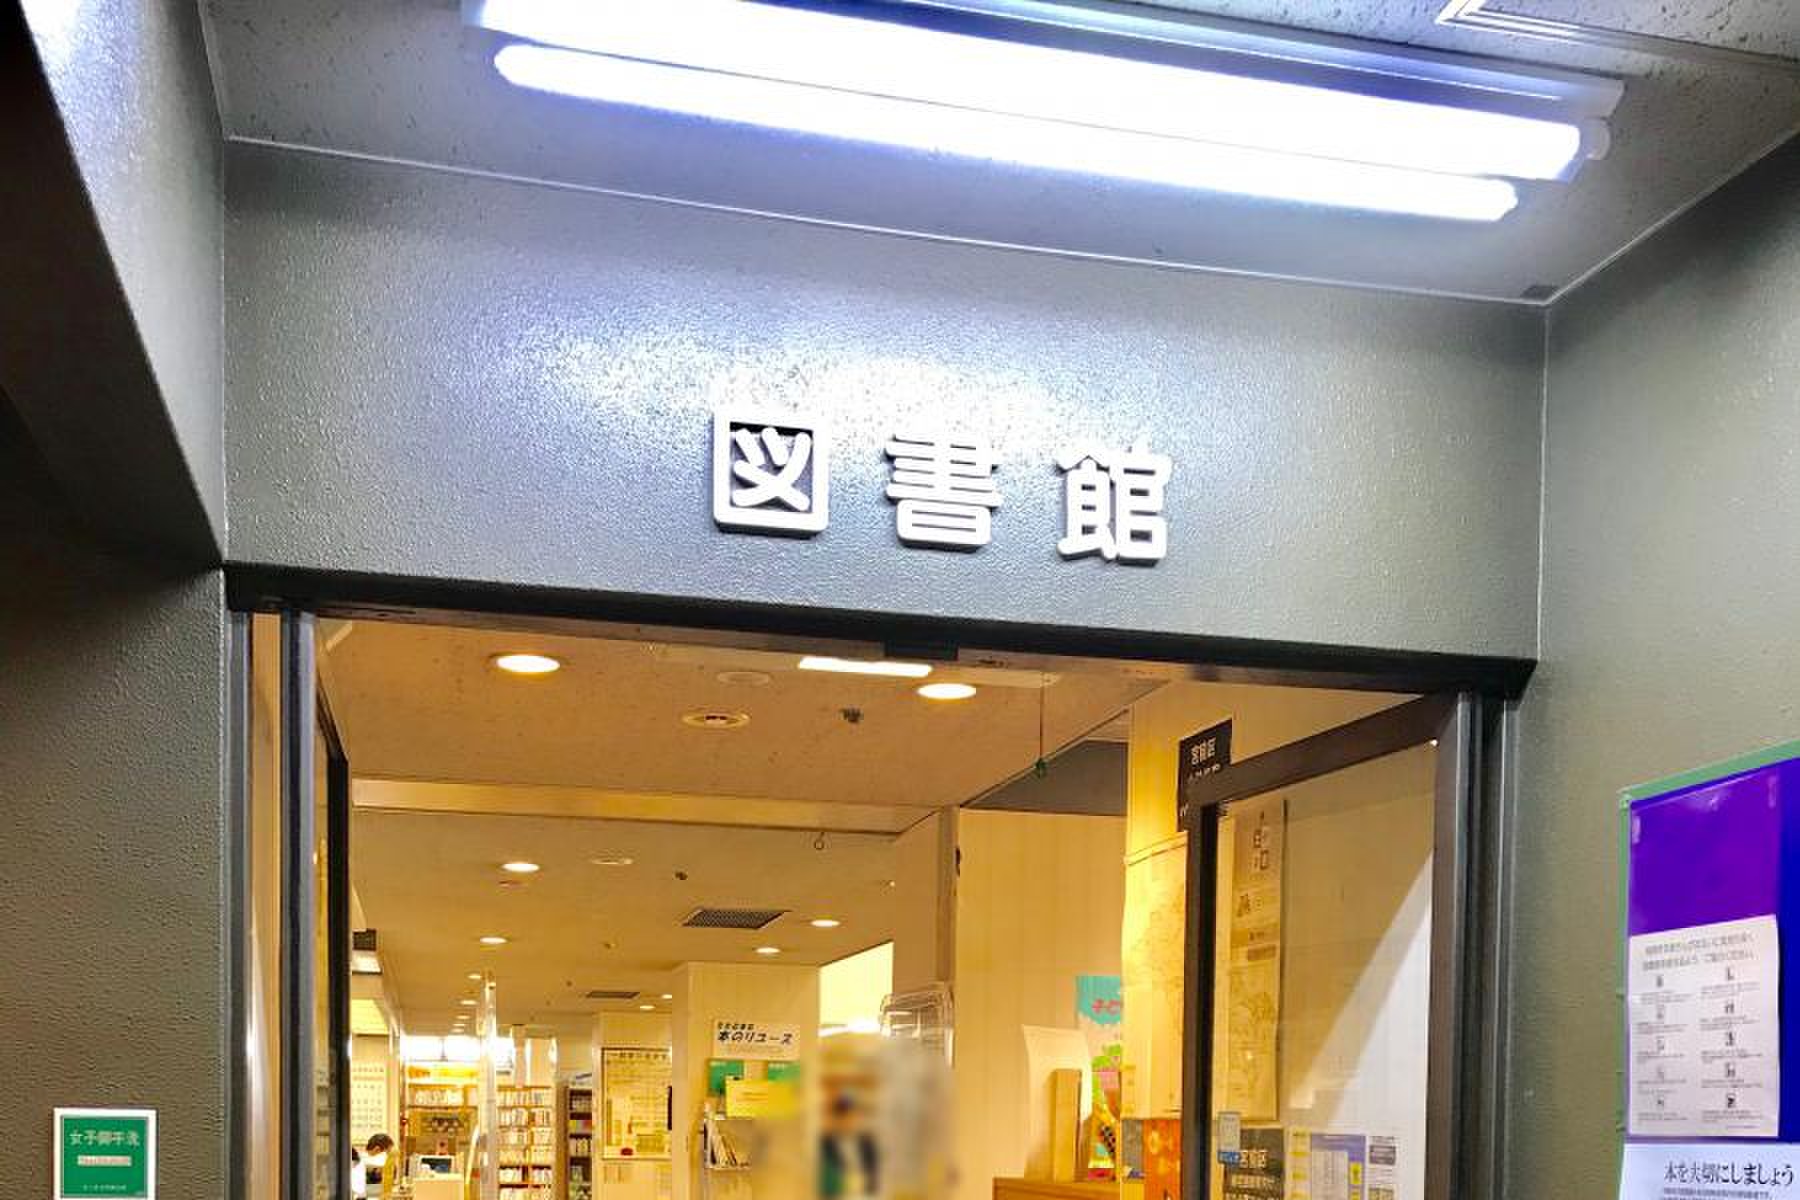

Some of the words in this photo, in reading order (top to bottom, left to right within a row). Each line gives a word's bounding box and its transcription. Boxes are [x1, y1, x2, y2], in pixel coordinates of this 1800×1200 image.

[713, 410, 1173, 565] 図書館
[718, 1031, 792, 1045] 本のリユース
[1664, 1161, 1794, 1187] 本を大切にしましょう
